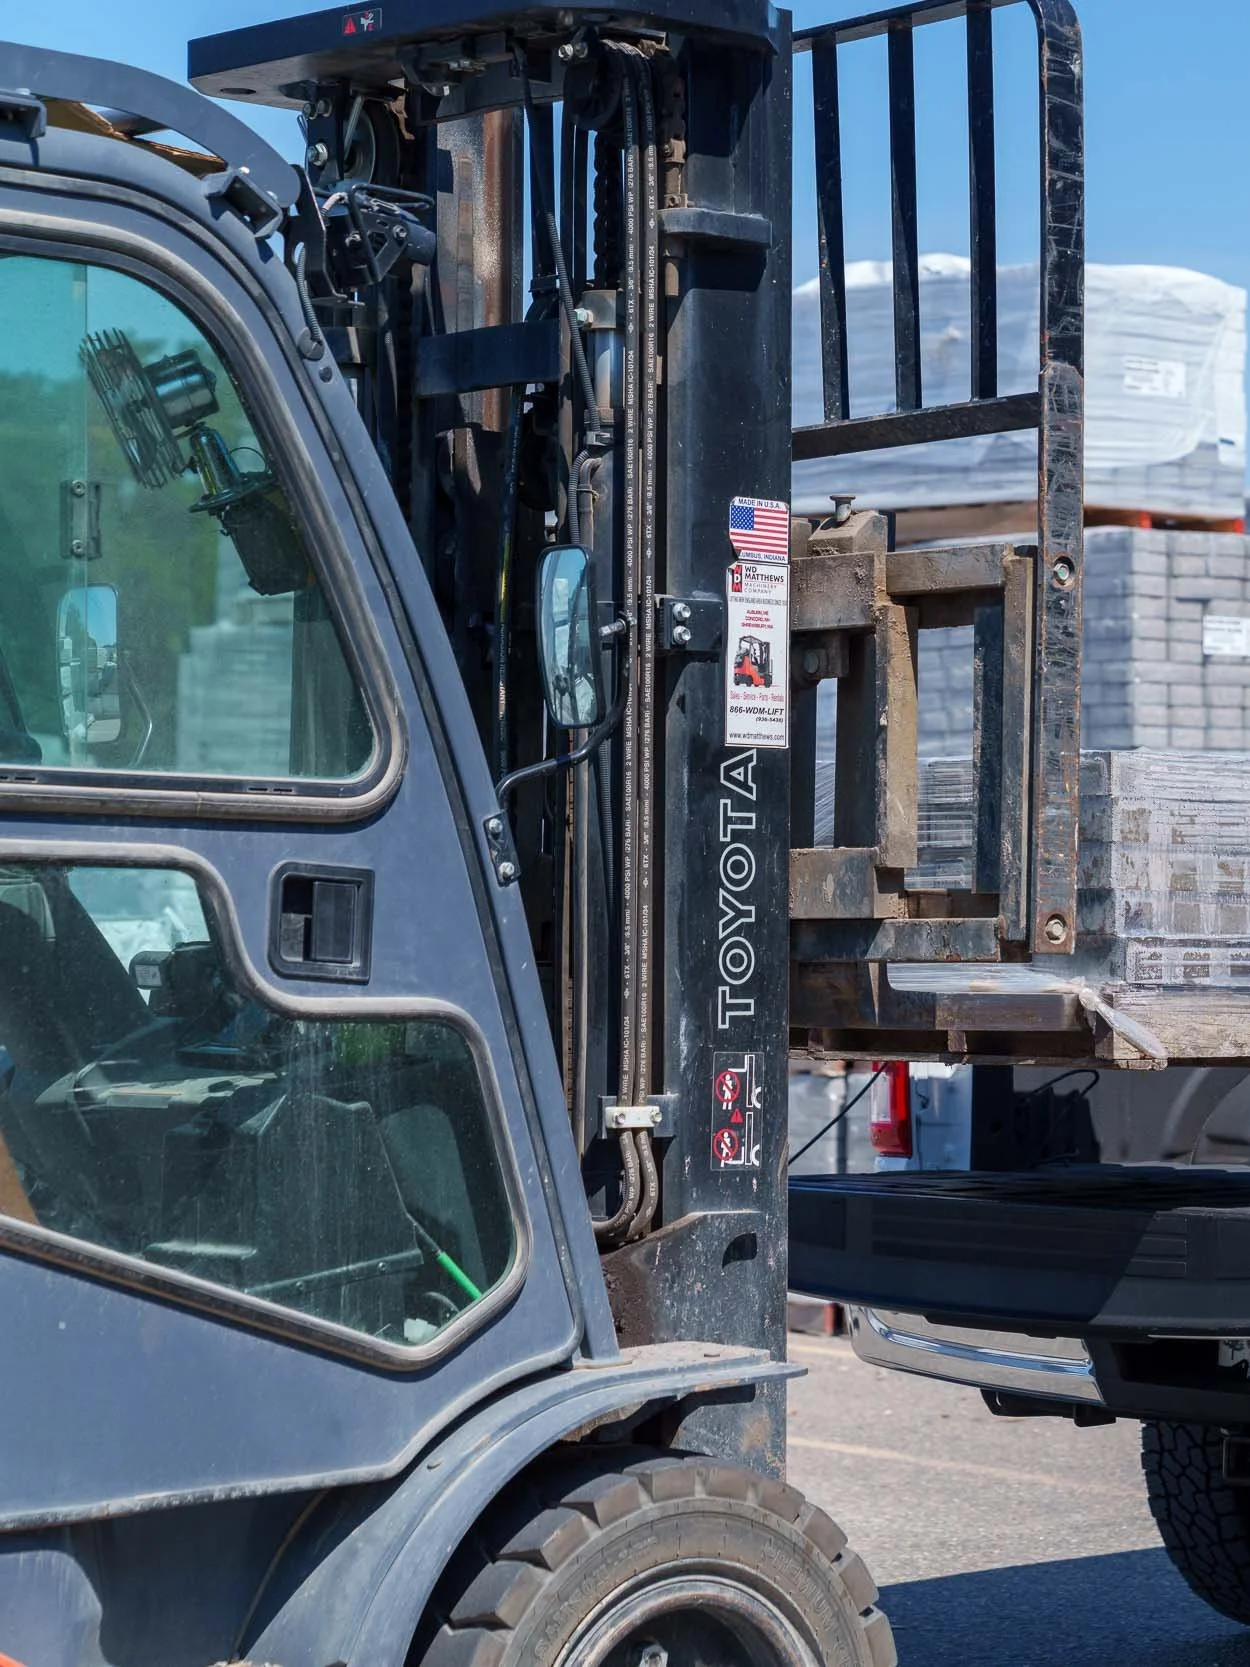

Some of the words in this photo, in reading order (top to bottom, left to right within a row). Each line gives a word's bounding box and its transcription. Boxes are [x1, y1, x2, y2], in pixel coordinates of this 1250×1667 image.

[628, 192, 634, 204] WP
[647, 417, 654, 430] WP
[738, 498, 756, 507] MADE
[627, 524, 633, 536] WP
[763, 553, 786, 562] INDIANA
[744, 565, 757, 573] WD
[744, 573, 785, 583] MATTHEWS
[729, 705, 785, 715] 866-WDM-LIFT
[729, 732, 785, 740] www.wdmatthews.com
[643, 747, 651, 759] WP
[624, 856, 631, 869] WP
[717, 748, 757, 1029] TOYOTA
[639, 1077, 646, 1090] WP
[638, 1091, 646, 1103] PSI
[628, 1186, 635, 1200] WP
[762, 1541, 838, 1633] PREMIUM
